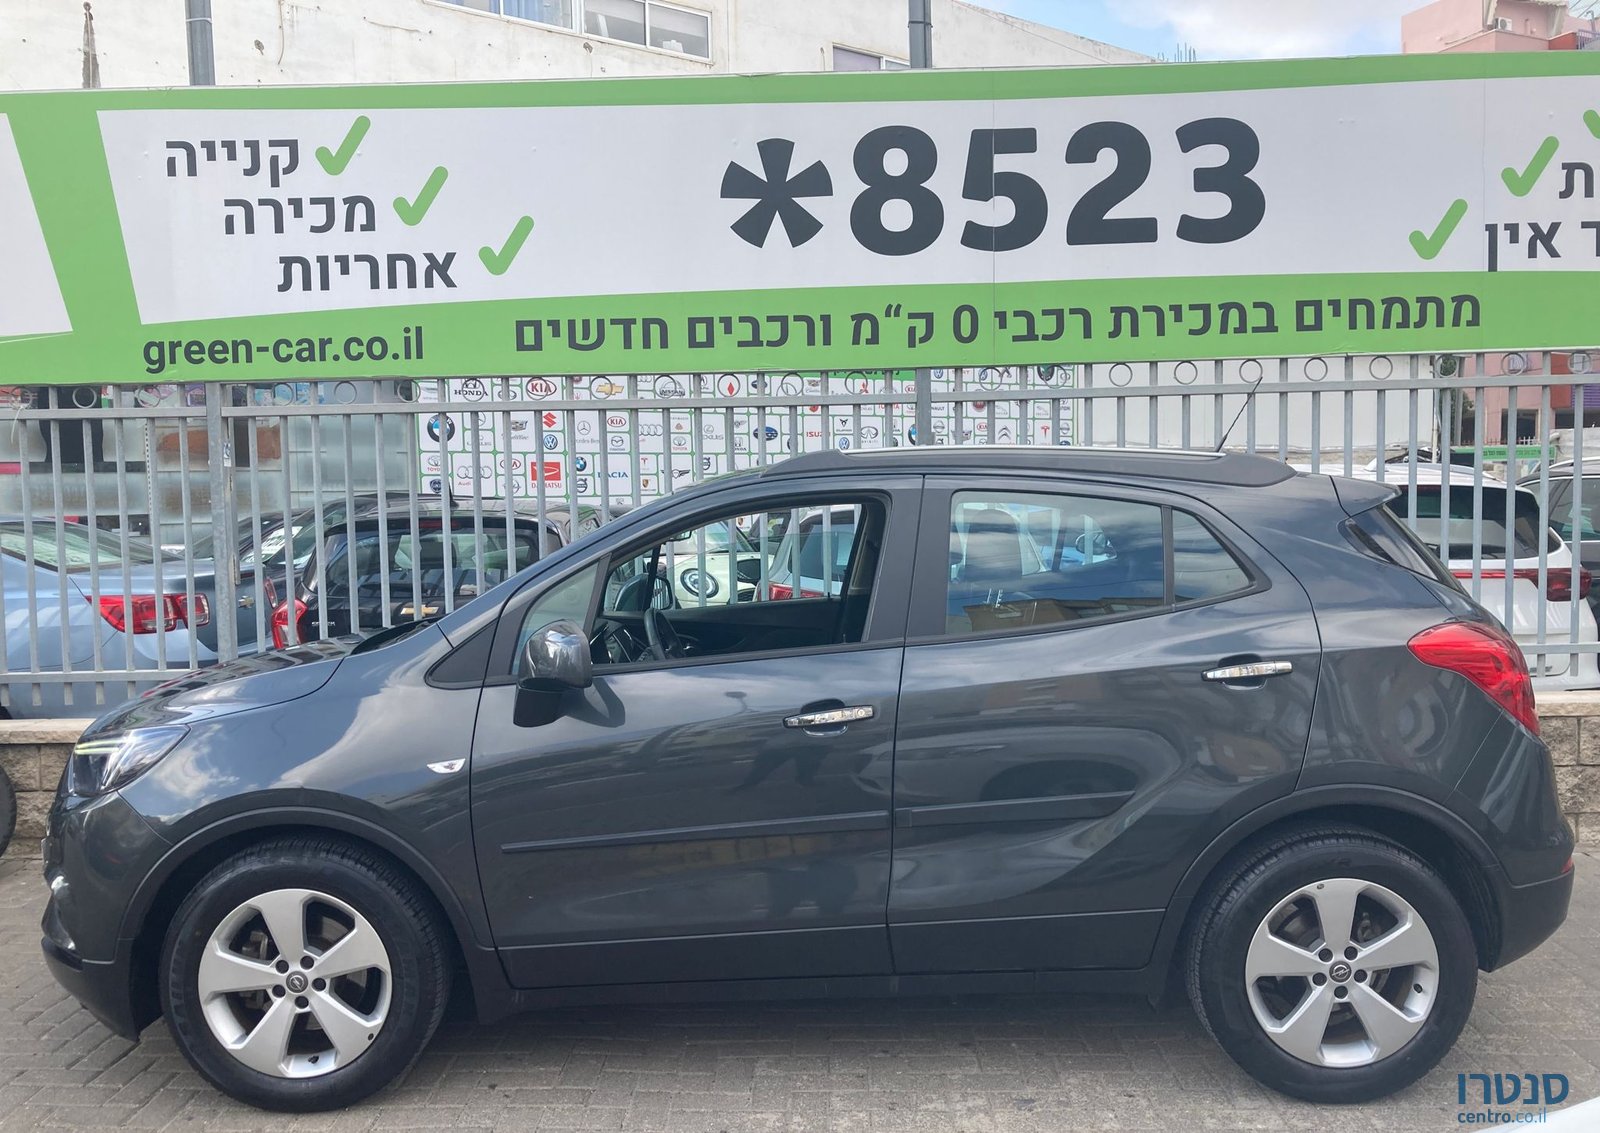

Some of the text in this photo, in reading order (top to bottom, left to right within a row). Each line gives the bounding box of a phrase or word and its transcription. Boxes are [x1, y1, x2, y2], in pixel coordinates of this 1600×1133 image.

[165, 138, 300, 188] קנייה
[223, 194, 377, 236] מכירה
[1484, 221, 1563, 273] אין
[276, 250, 458, 293] אחריות
[687, 313, 832, 349] ורכבים
[952, 304, 980, 345] 0
[994, 307, 1093, 343] רכבי
[1107, 301, 1279, 340] במכירת
[1295, 294, 1481, 332] מתמחים
[142, 325, 424, 374] green-car.co.il
[515, 317, 669, 352] חדשים
[453, 389, 489, 397] HONDA
[531, 382, 552, 393] KIA
[610, 418, 624, 426] KIA
